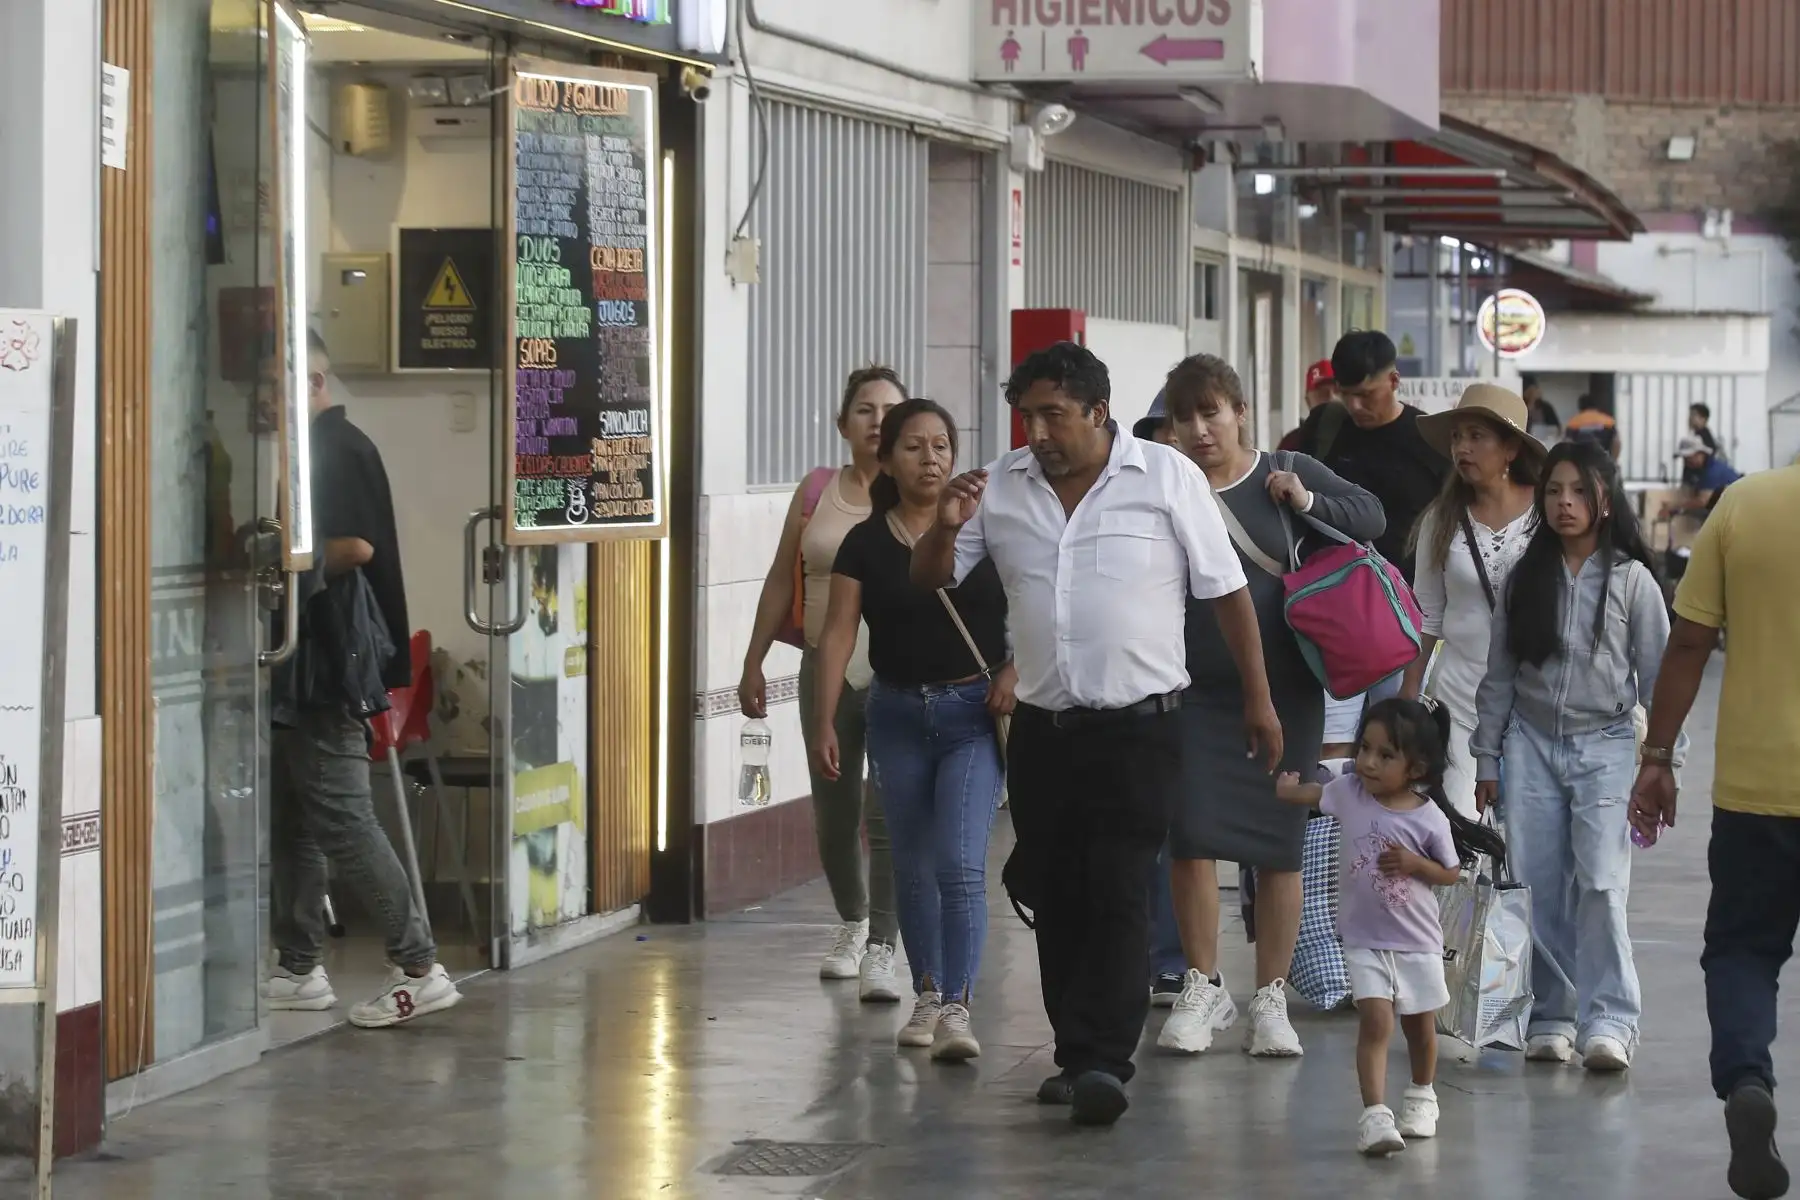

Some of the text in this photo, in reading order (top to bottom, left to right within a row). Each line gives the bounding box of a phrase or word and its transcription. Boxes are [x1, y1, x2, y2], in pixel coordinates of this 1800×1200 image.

[518, 235, 561, 263] DUOS
[599, 300, 636, 323] JUGOS
[520, 339, 558, 364] SOPAS
[600, 410, 648, 435] SANDWICH
